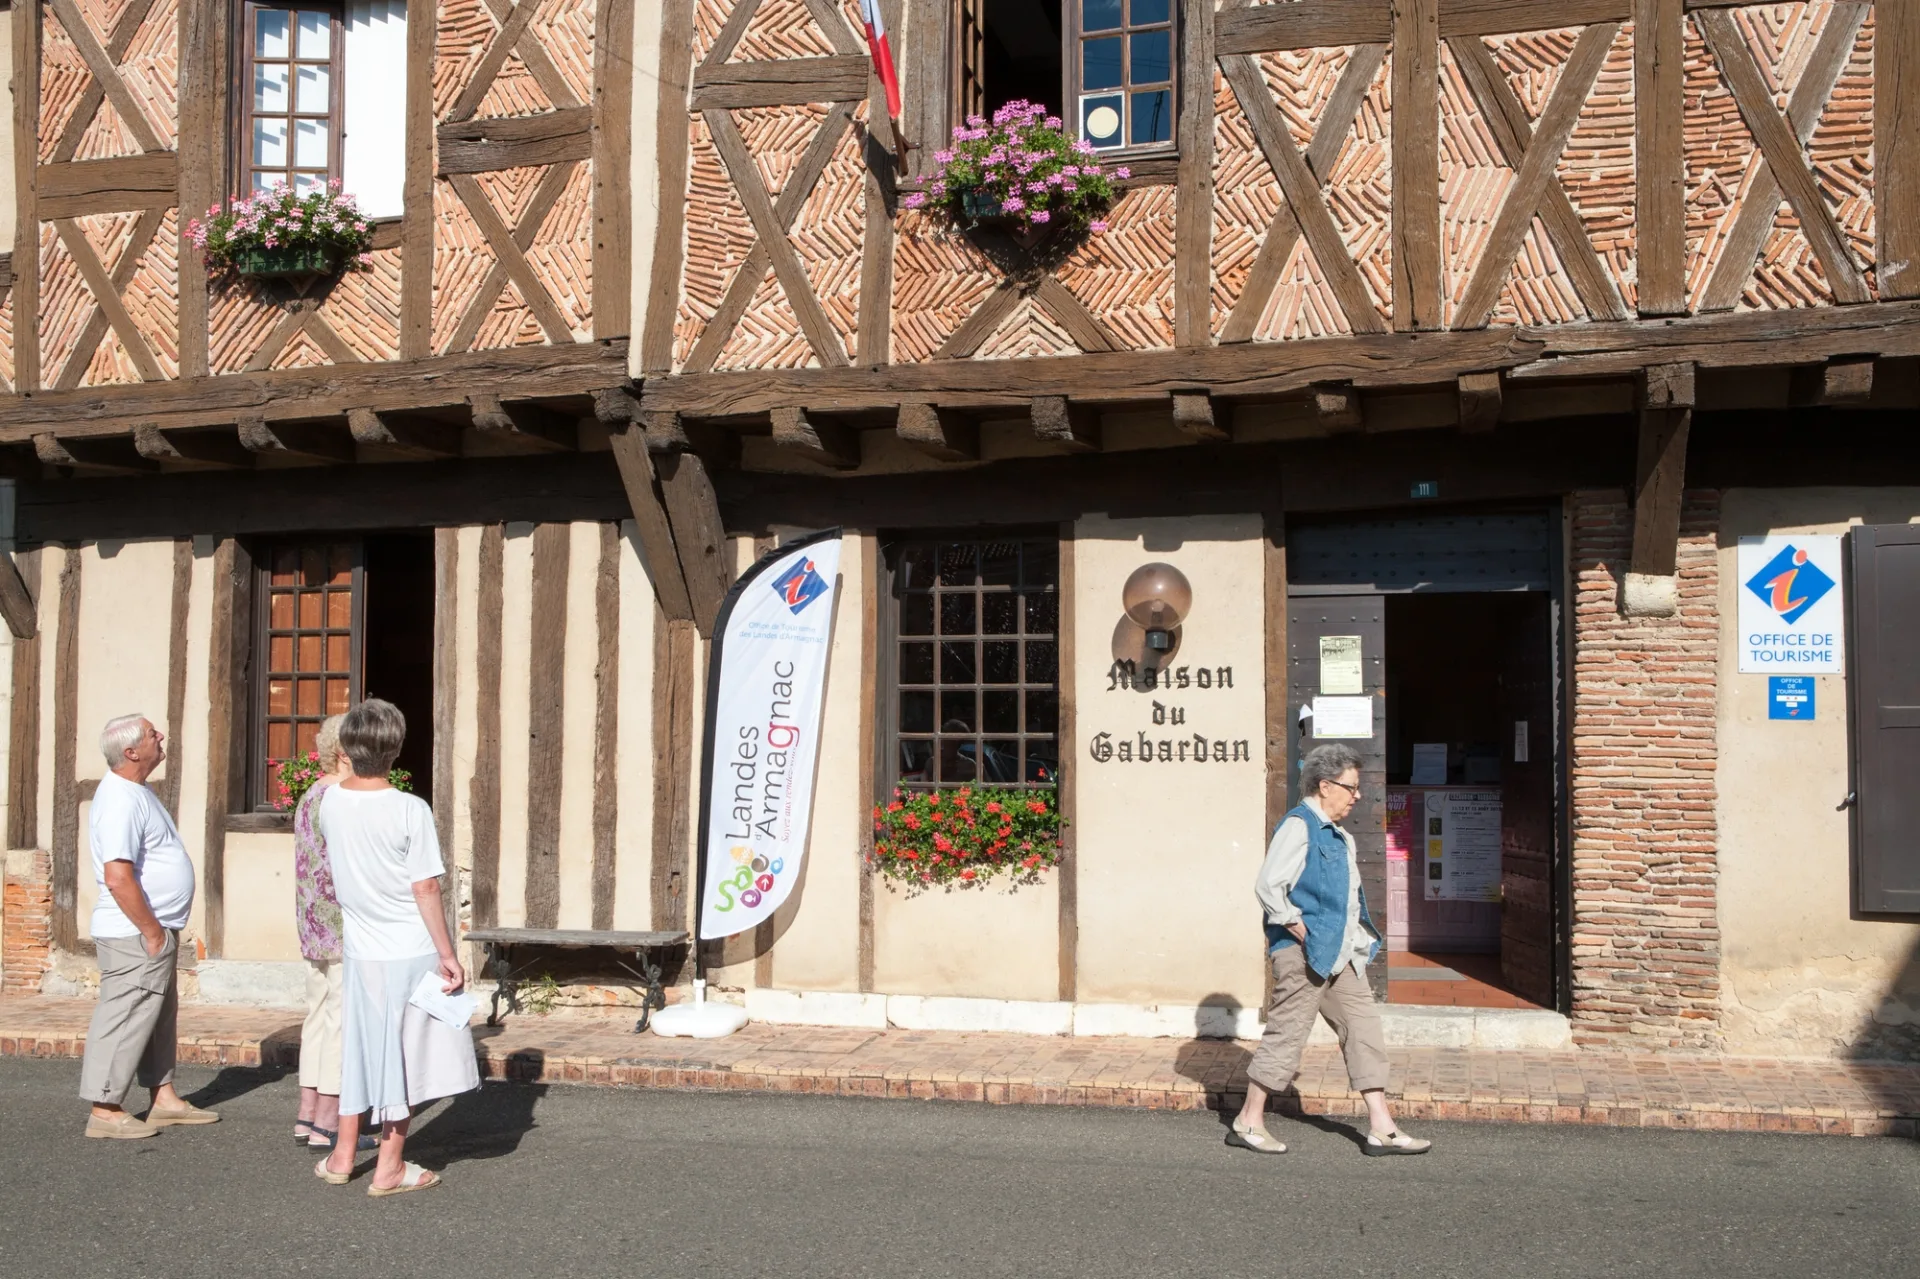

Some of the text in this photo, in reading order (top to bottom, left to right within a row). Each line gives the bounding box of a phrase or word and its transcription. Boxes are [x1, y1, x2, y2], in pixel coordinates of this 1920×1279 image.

[1418, 483, 1430, 496] 111
[739, 630, 824, 644] des Landes d'Armagnac
[1749, 633, 1833, 646] OFFICE DE
[1750, 650, 1833, 662] TOURISME
[1106, 658, 1234, 693] Maison
[1152, 699, 1186, 726] du
[1090, 730, 1251, 763] Gabardan
[726, 725, 760, 841] Landes
[783, 801, 793, 817] aux
[780, 818, 792, 843] Soyez
